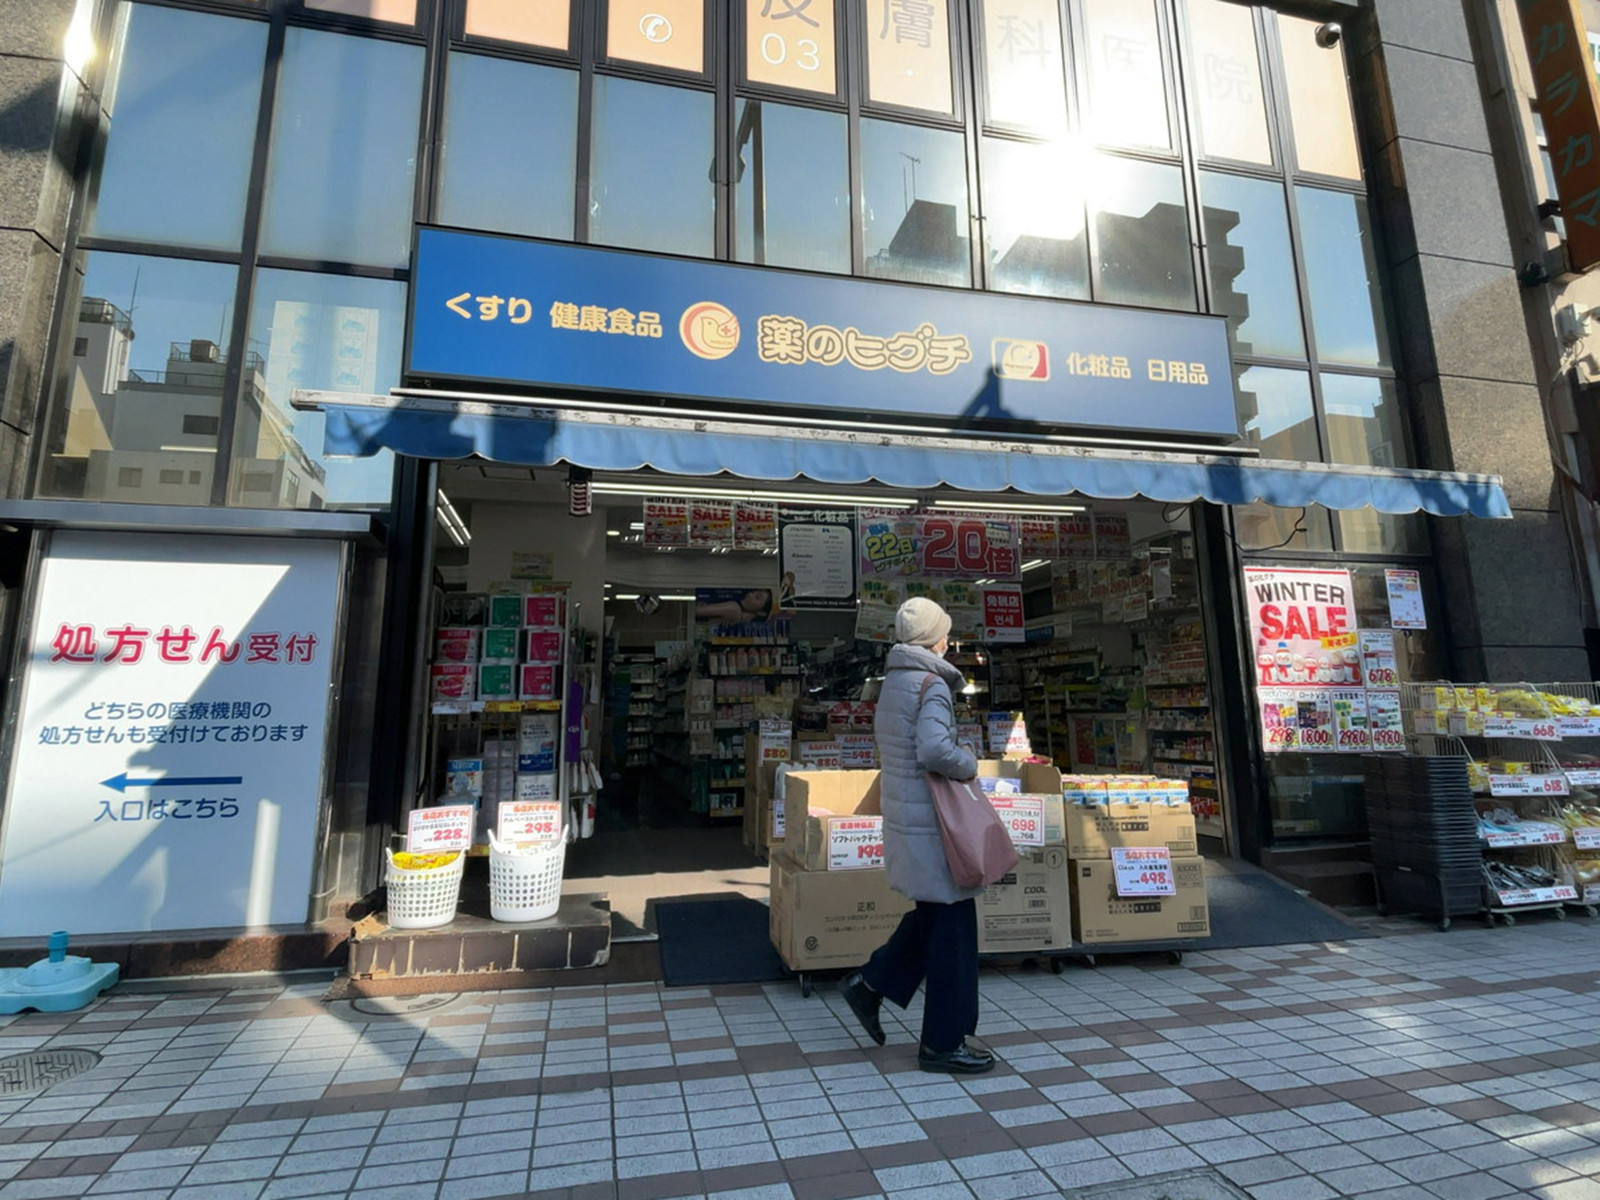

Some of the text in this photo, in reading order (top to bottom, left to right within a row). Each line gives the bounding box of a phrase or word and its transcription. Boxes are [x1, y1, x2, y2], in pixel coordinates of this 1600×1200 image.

[446, 292, 663, 338] くすり 健康食品
[757, 314, 972, 375] 薬のヒグチ
[1066, 352, 1209, 385] 化粧品 日用品
[647, 505, 686, 517] SALE
[693, 508, 731, 520] SALE
[737, 510, 773, 522] SALE
[1023, 522, 1055, 534] SALE
[1060, 522, 1091, 535] SALE
[866, 533, 916, 561] 22日
[922, 518, 1014, 574] 20倍
[1255, 582, 1346, 605] WINTER
[1260, 604, 1350, 640] SALE
[50, 622, 319, 665] 処方せん受付
[83, 701, 272, 720] どちらの医療機関の
[38, 724, 308, 745] 処方せんも受付けております
[1533, 724, 1555, 737] 668
[93, 797, 240, 822] 入口はこちら
[525, 822, 553, 834] 298
[1011, 819, 1036, 832] 698
[433, 828, 463, 842] 228
[857, 844, 885, 859] 198
[1140, 872, 1167, 885] 498
